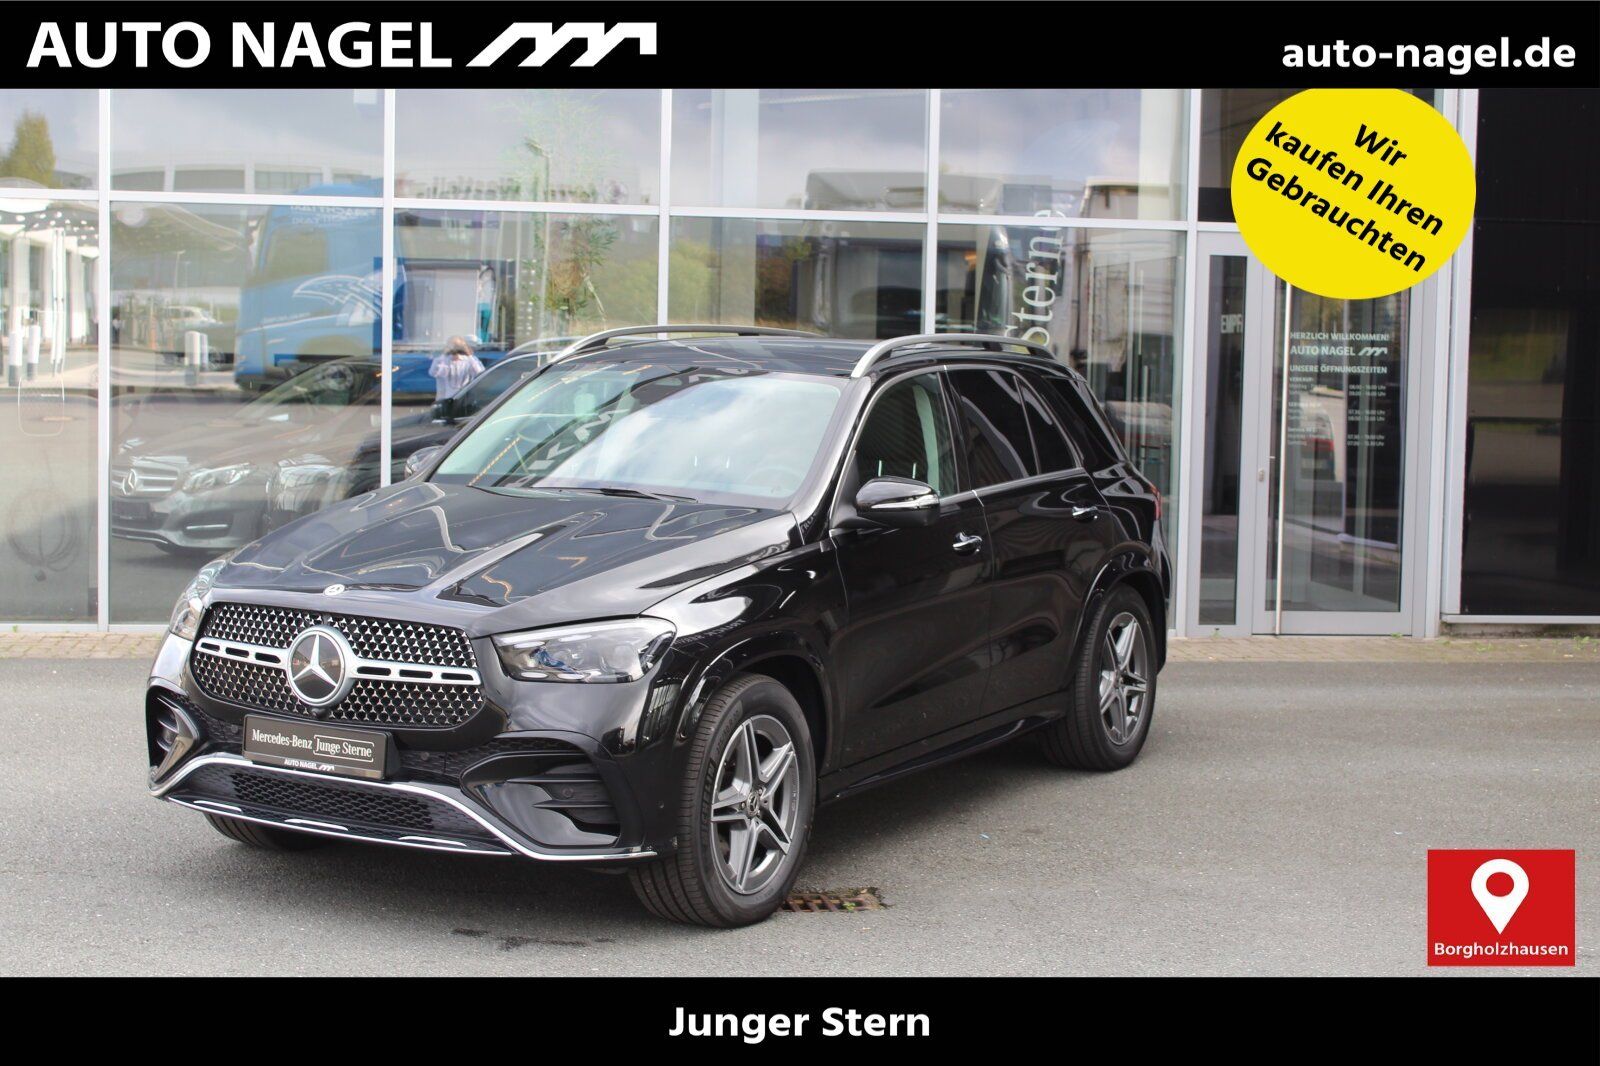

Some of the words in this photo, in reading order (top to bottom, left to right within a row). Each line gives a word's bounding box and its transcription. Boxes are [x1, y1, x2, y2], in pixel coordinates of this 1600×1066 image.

[1290, 332, 1329, 340] HERZLICH
[1331, 332, 1389, 341] WILLKOMMEN!
[1290, 345, 1319, 356] AUTO
[1321, 346, 1355, 356] NAGEL
[1290, 364, 1319, 373] UNSERE
[1320, 364, 1388, 374] ÖFFNUNGSZEITEN
[252, 728, 313, 749] Mercedes-Benz
[315, 737, 341, 755] Junge
[341, 741, 373, 758] Sterne
[284, 758, 300, 767] AUTO
[299, 761, 319, 770] NAGEL
